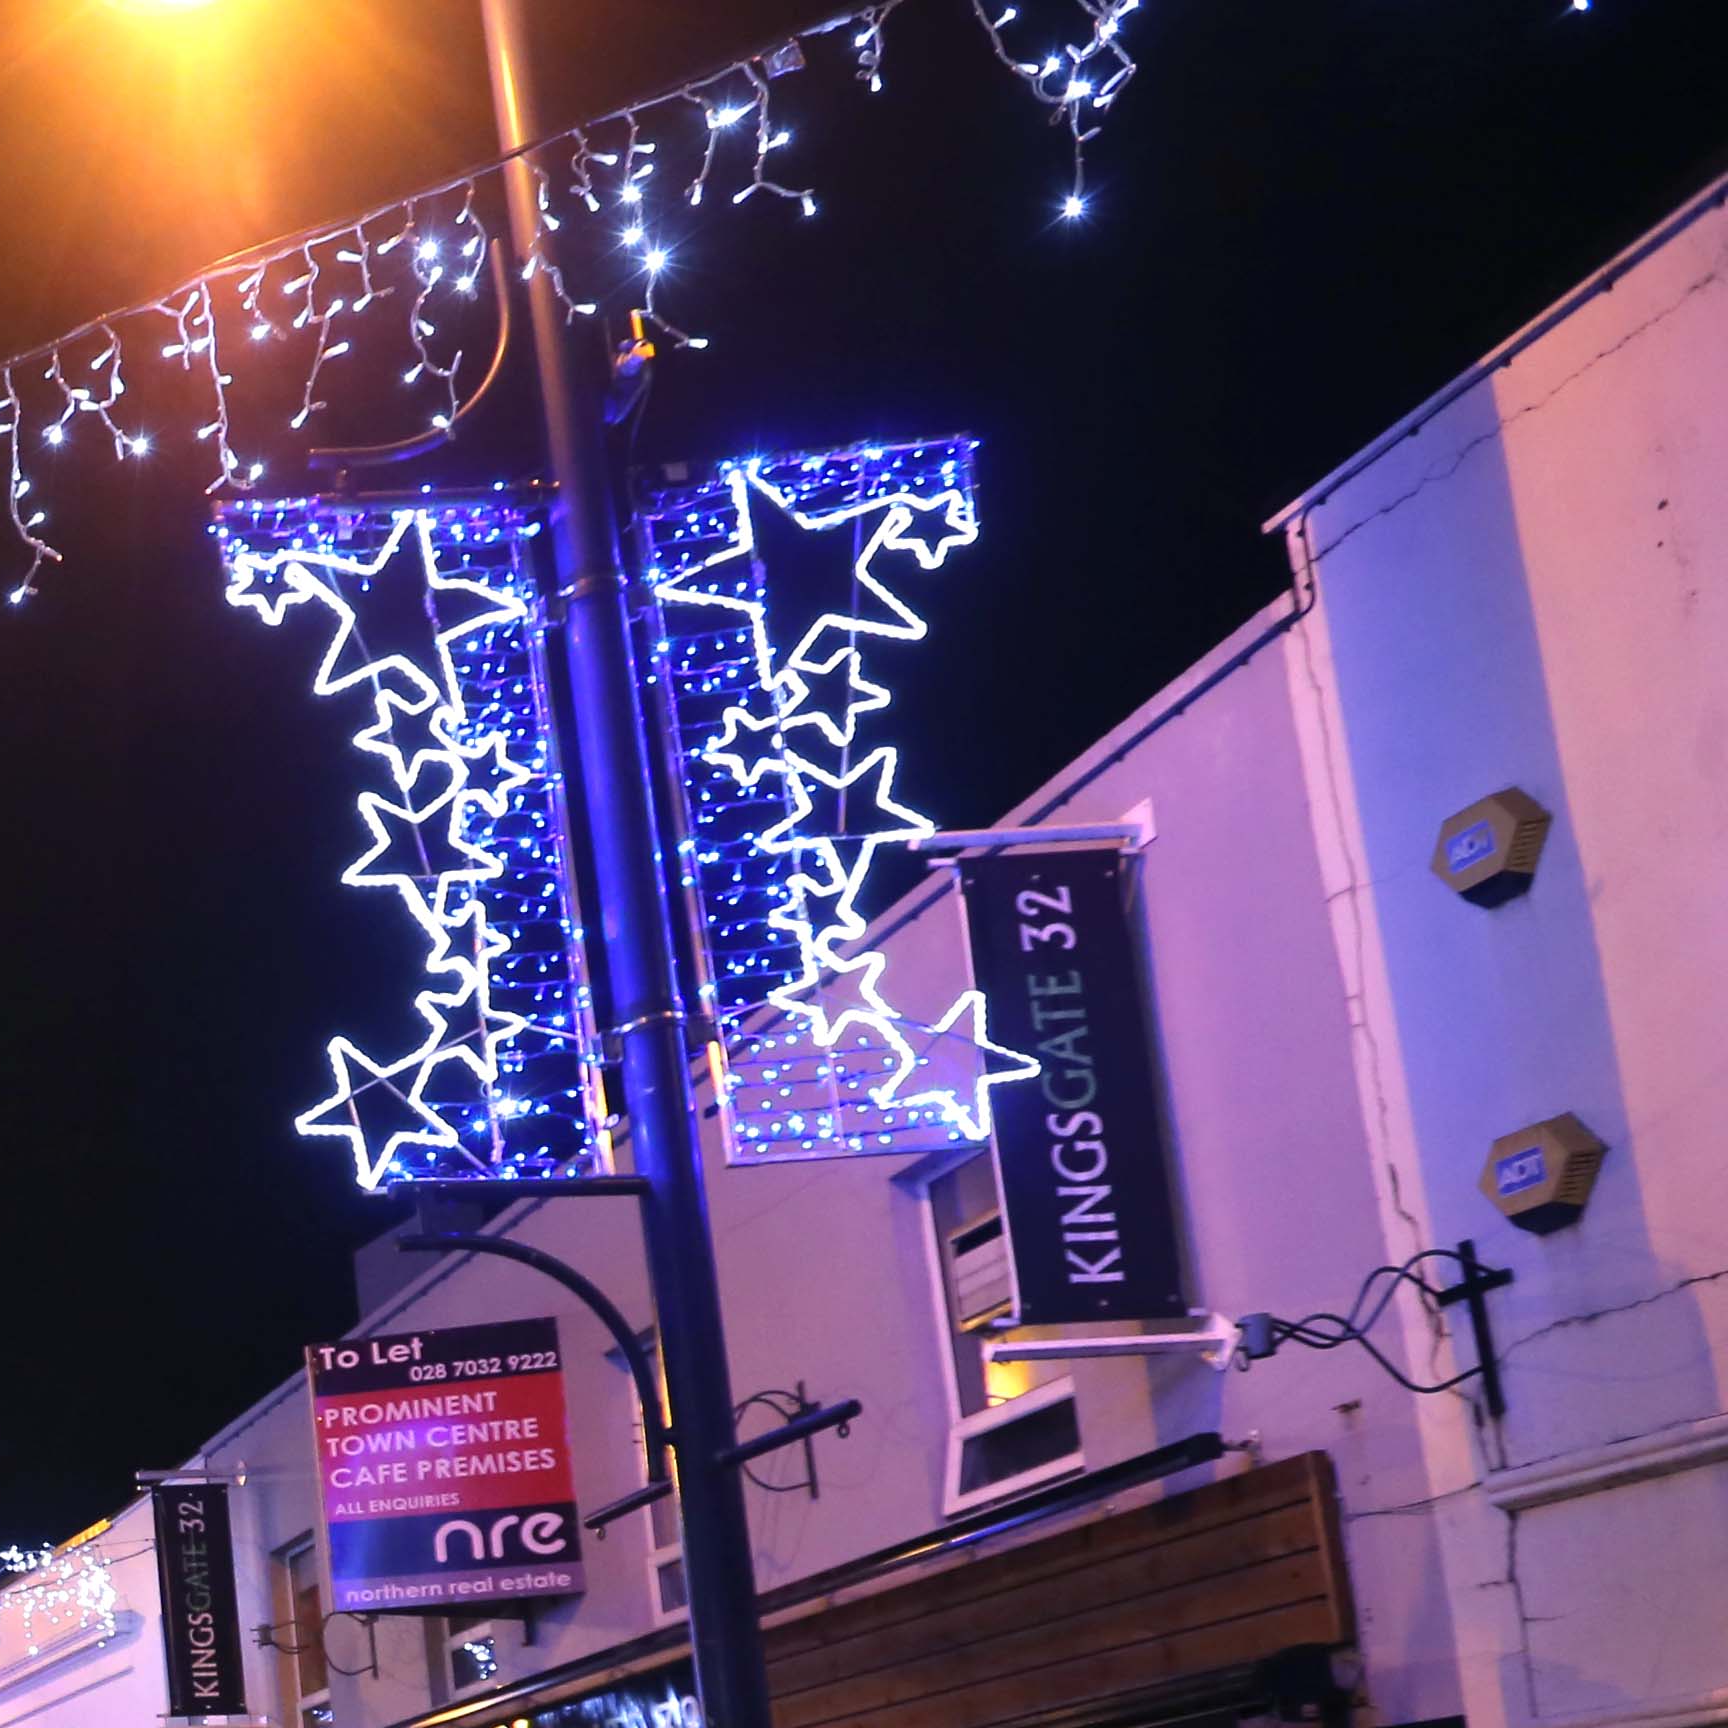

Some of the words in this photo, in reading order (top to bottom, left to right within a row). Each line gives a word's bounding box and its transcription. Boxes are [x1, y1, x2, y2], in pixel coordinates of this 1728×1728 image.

[1015, 885, 1078, 952] 32
[1026, 969, 1126, 1285] KINGSGATE
[1498, 1154, 1542, 1185] ADT
[319, 1347, 360, 1370] To
[372, 1337, 423, 1364] Let
[410, 1363, 447, 1382] 028
[453, 1357, 502, 1378] 7032
[508, 1351, 558, 1371] 9222
[324, 1391, 497, 1429] PROMINENT
[326, 1430, 415, 1457] TOWN
[426, 1417, 539, 1448] CENTRE
[330, 1462, 408, 1488] CAFE
[417, 1448, 556, 1481] PREMISES
[178, 1500, 205, 1533] 32
[335, 1502, 364, 1515] ALL
[370, 1492, 460, 1513] ENQUIRIES
[434, 1512, 567, 1562] nre
[346, 1578, 443, 1604] northern
[448, 1575, 494, 1595] real
[500, 1572, 571, 1591] estate
[182, 1541, 220, 1698] KINGSGATE
